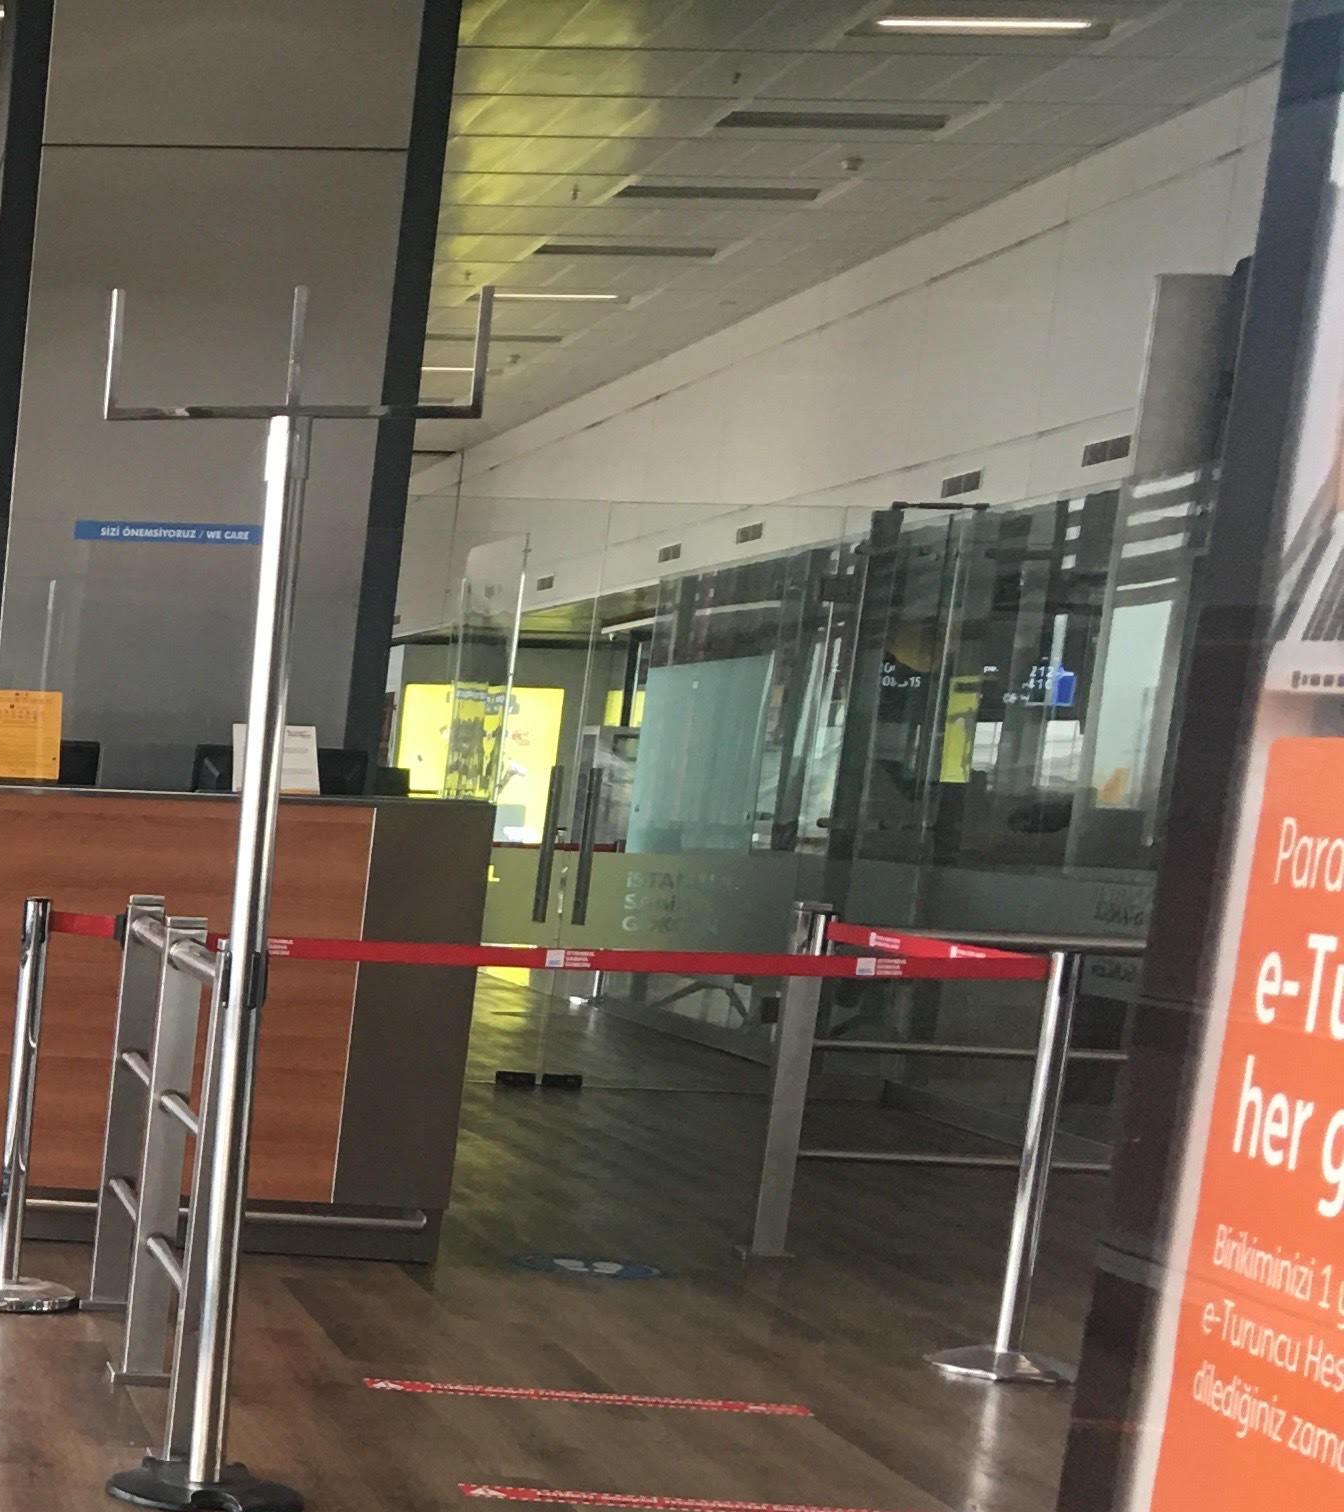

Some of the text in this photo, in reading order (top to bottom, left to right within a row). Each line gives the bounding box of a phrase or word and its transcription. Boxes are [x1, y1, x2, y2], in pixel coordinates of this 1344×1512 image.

[206, 530, 221, 539] WE
[1232, 1054, 1314, 1171] her
[1318, 1264, 1333, 1310] 1
[1201, 1298, 1300, 1372] e-Turuncu
